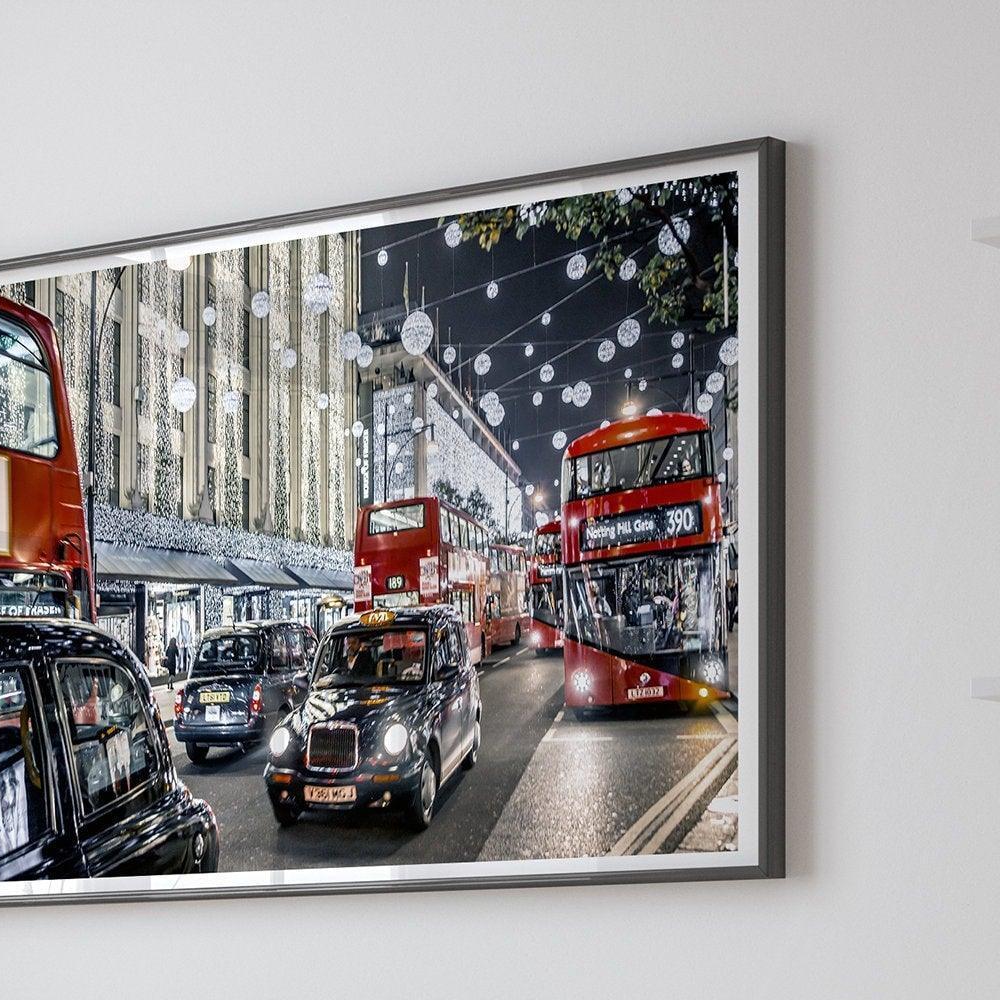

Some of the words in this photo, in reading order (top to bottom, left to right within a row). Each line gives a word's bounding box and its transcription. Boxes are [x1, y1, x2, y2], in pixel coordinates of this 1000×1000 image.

[586, 524, 616, 540] Notting
[617, 521, 632, 535] Hill
[633, 519, 654, 532] Gate
[666, 507, 693, 535] 390
[389, 576, 402, 589] 189
